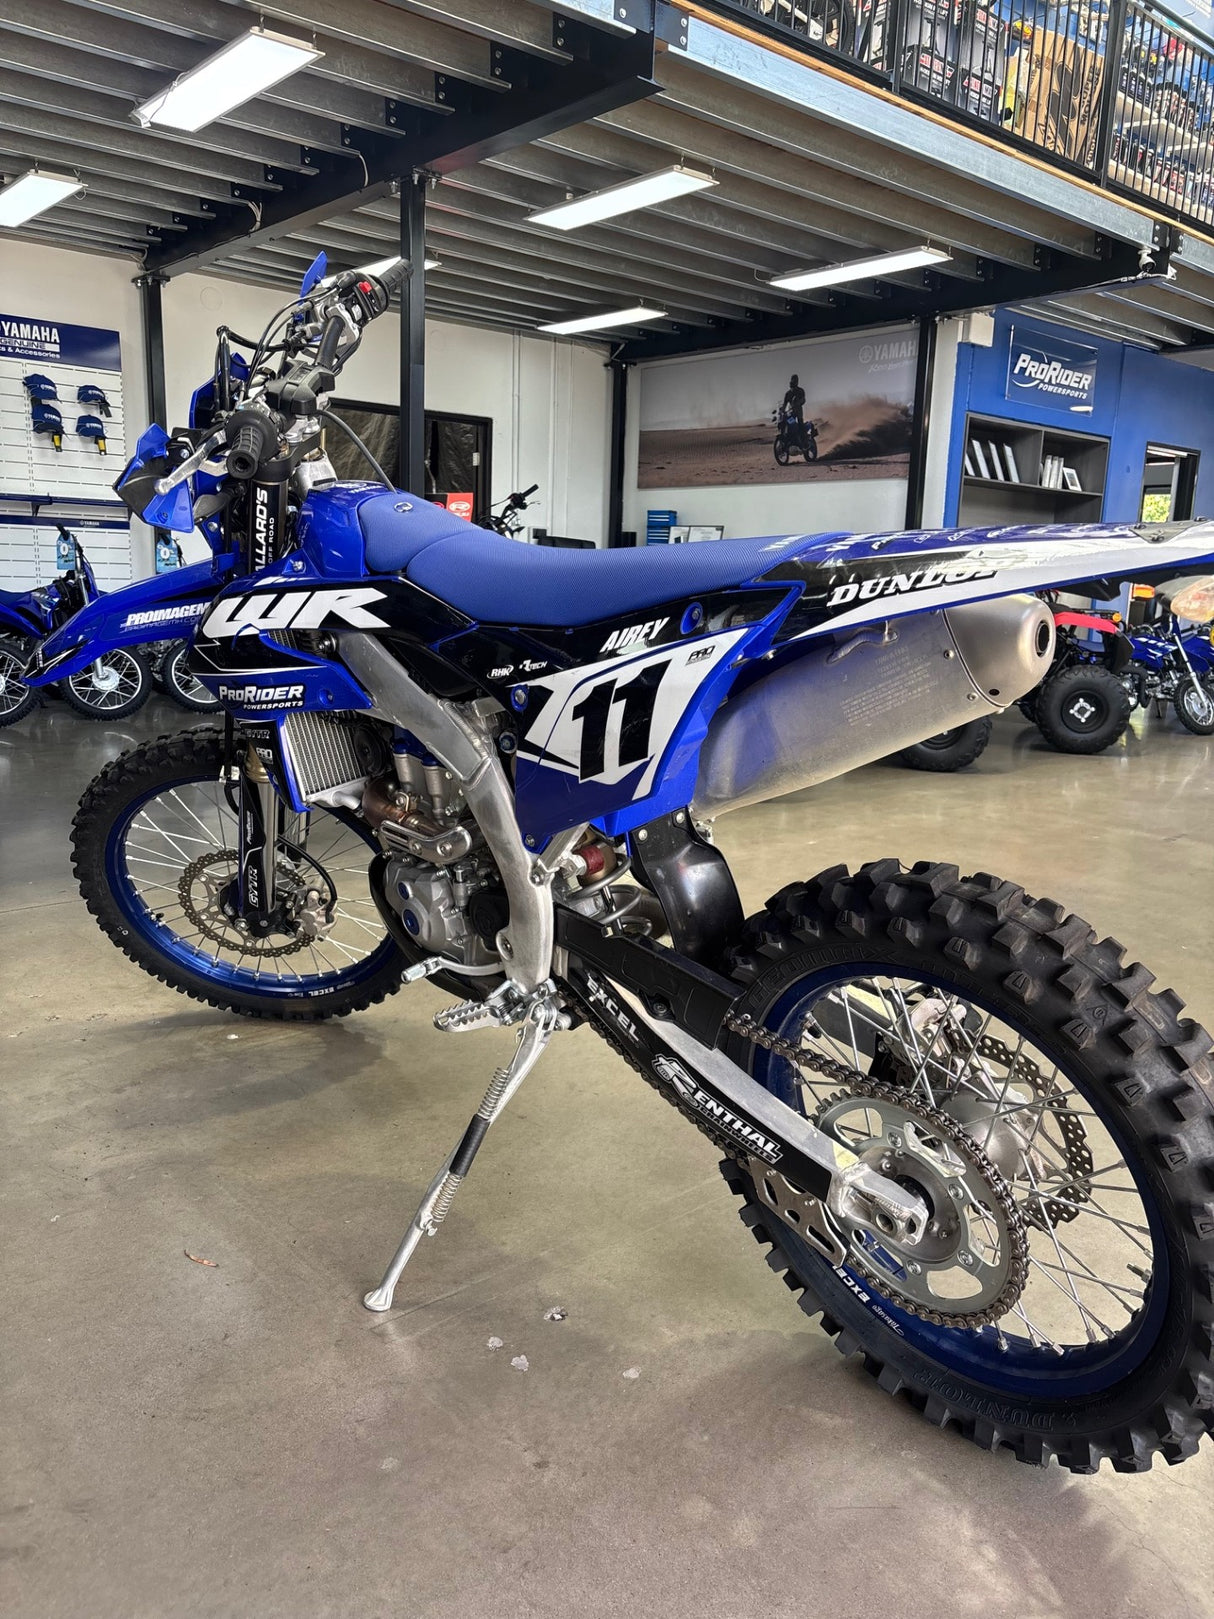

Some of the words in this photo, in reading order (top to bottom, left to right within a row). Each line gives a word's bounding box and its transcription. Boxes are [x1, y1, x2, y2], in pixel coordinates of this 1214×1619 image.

[1, 321, 60, 343] YAMAHA
[1, 338, 46, 349] GENUINE
[15, 348, 61, 359] Accessories
[874, 340, 918, 361] YAMAH
[1038, 383, 1088, 400] POWERSPORTS
[126, 601, 212, 627] PROIMAGEM
[203, 587, 391, 639] WR
[599, 617, 670, 654] AIREY
[491, 667, 510, 677] RHK
[243, 700, 304, 711] POWERSPORTS
[571, 659, 673, 781] 11
[249, 865, 258, 908] GYTR
[308, 986, 335, 997] EXCEL
[586, 977, 640, 1042] EXCEL
[652, 1055, 780, 1158] RENTHAL
[699, 1106, 777, 1163] CHAINWHEELS
